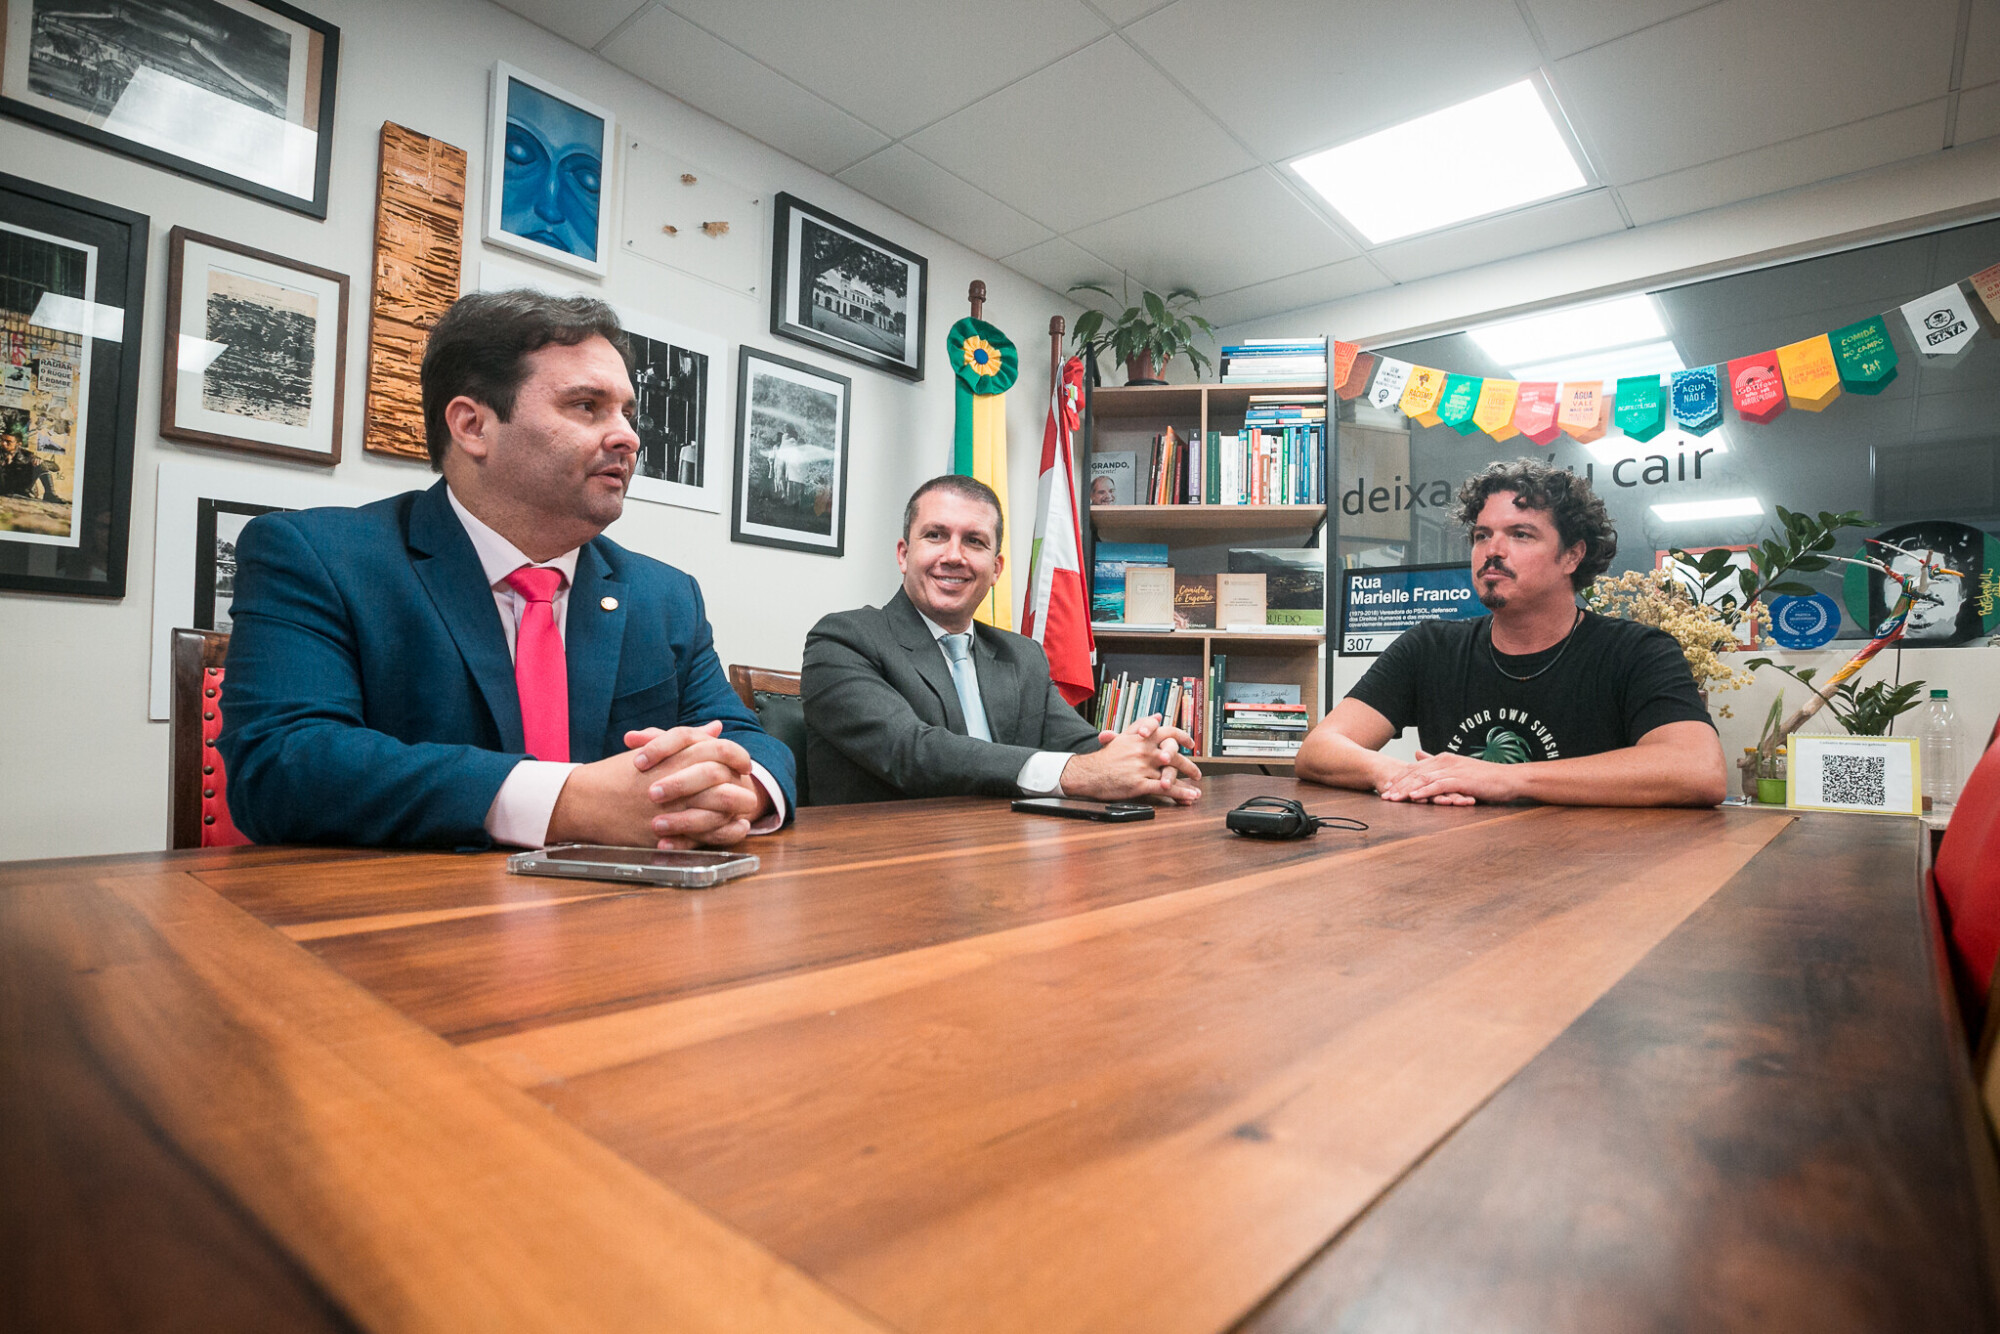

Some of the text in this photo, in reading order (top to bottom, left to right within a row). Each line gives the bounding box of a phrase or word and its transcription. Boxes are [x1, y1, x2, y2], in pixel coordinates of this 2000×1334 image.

[1841, 325, 1876, 346] COMIDA
[1929, 325, 1966, 345] MATA
[1843, 338, 1884, 358] NO CAMPO
[1408, 389, 1433, 401] RACISMO
[1684, 391, 1706, 403] NÃO É
[1611, 441, 1714, 488] cair
[1179, 585, 1206, 595] Comida
[1351, 576, 1381, 590] Rua
[1184, 590, 1214, 606] Engenho
[1350, 587, 1471, 605] Marielle Franco
[1285, 614, 1302, 623] DO
[1347, 638, 1373, 651] 307
[1447, 708, 1560, 759] KE YOUR OWN SUNSH
